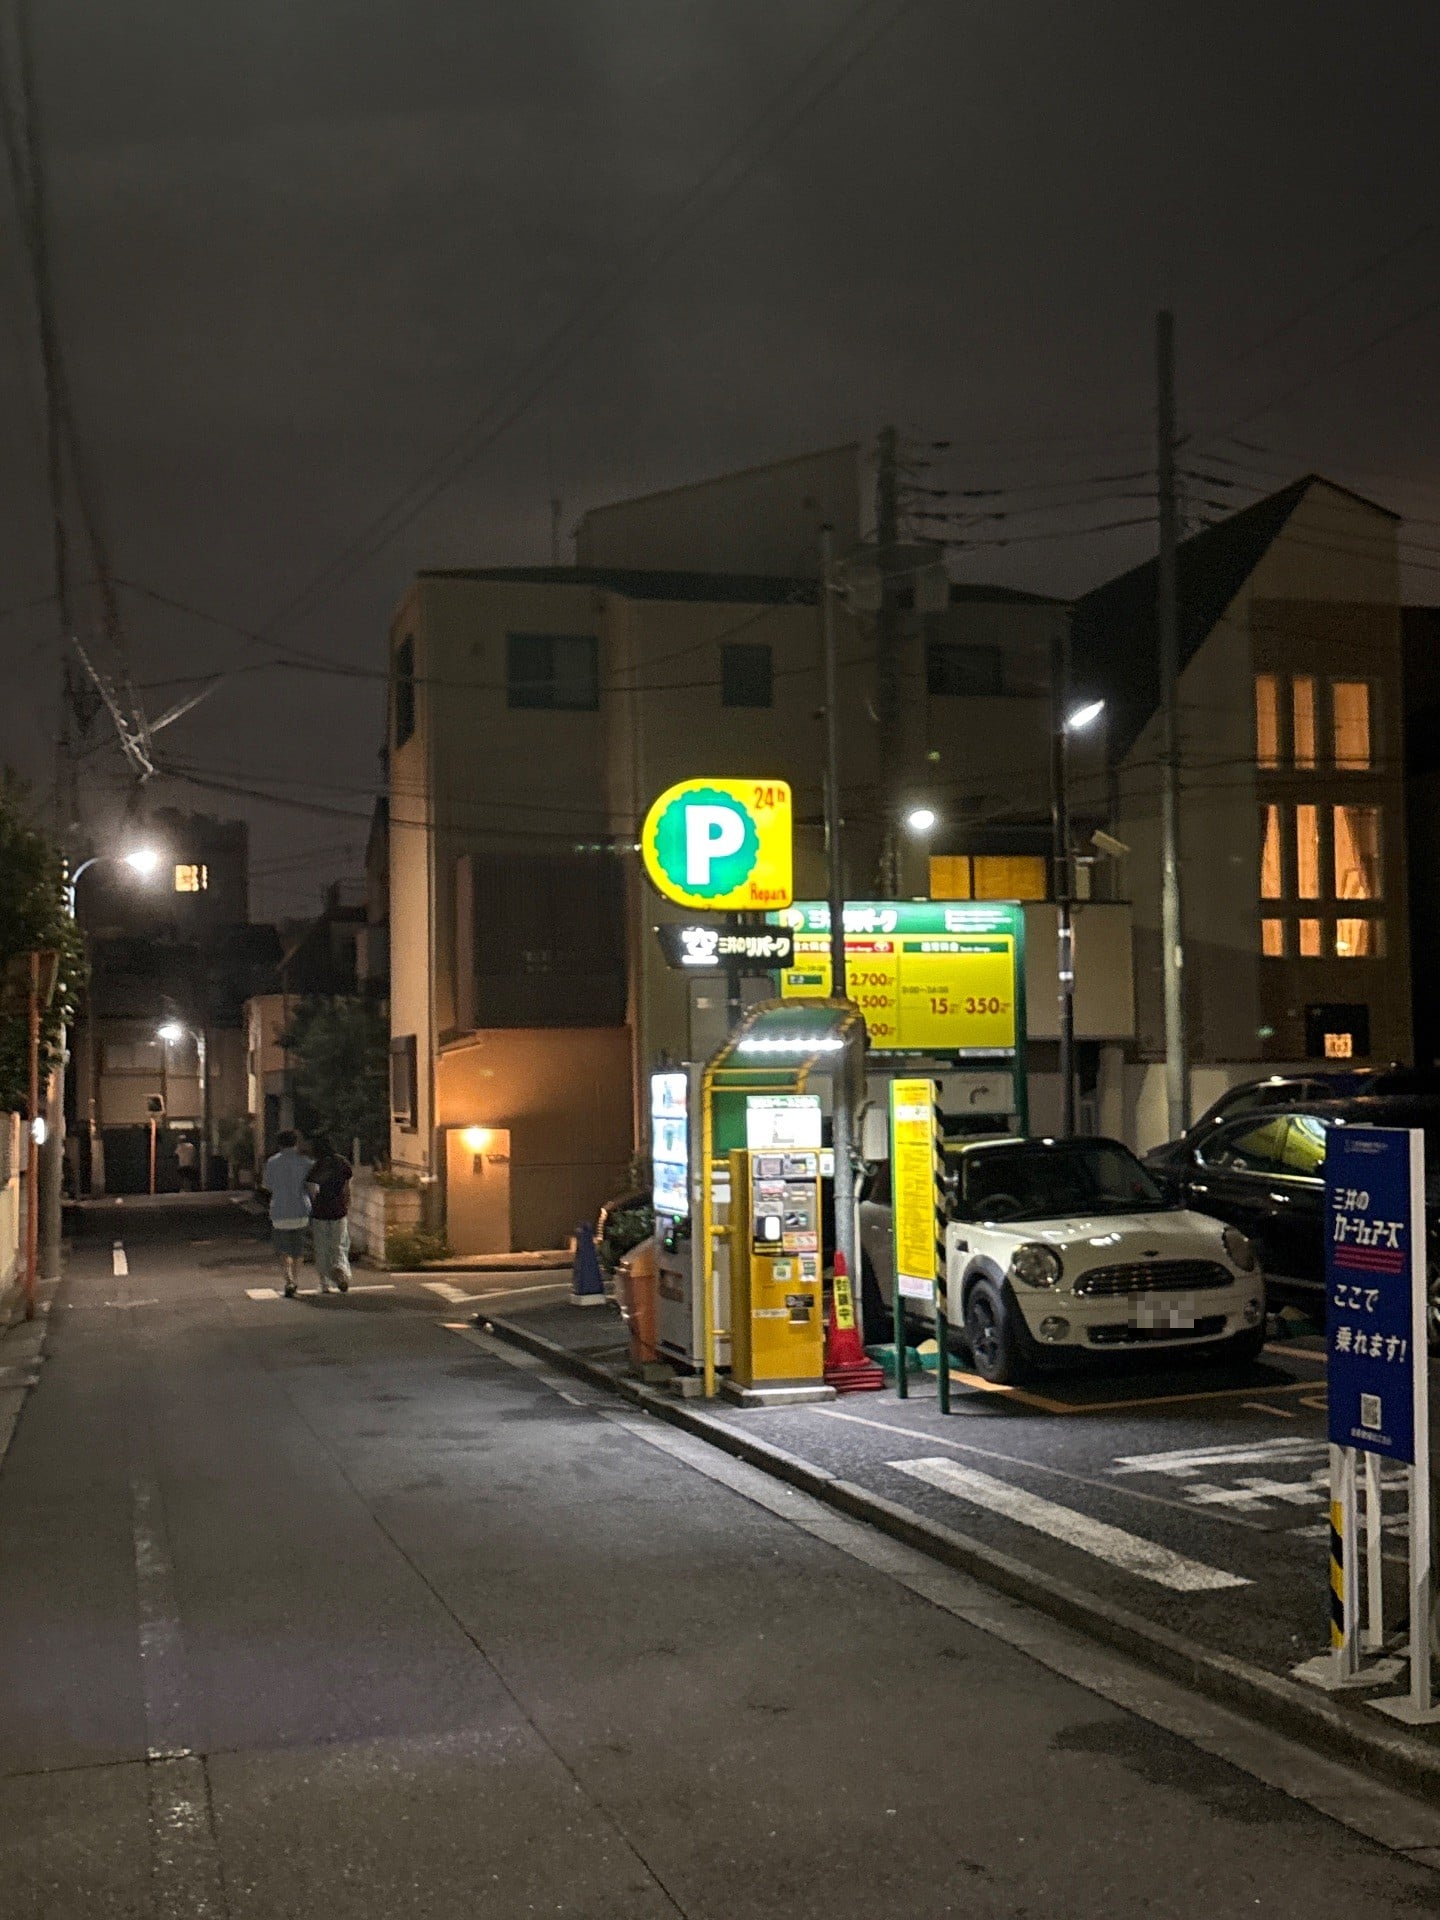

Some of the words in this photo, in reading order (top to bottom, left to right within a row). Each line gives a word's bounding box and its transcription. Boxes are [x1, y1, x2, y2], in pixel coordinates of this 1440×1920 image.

[685, 804, 746, 885] P
[750, 883, 787, 902] Repark
[681, 928, 719, 964] 空
[930, 997, 948, 1014] 15
[965, 997, 1000, 1014] 350
[1332, 1188, 1370, 1211] 三井の
[1334, 1284, 1379, 1313] ここで
[1335, 1326, 1407, 1363] 乗れます!
